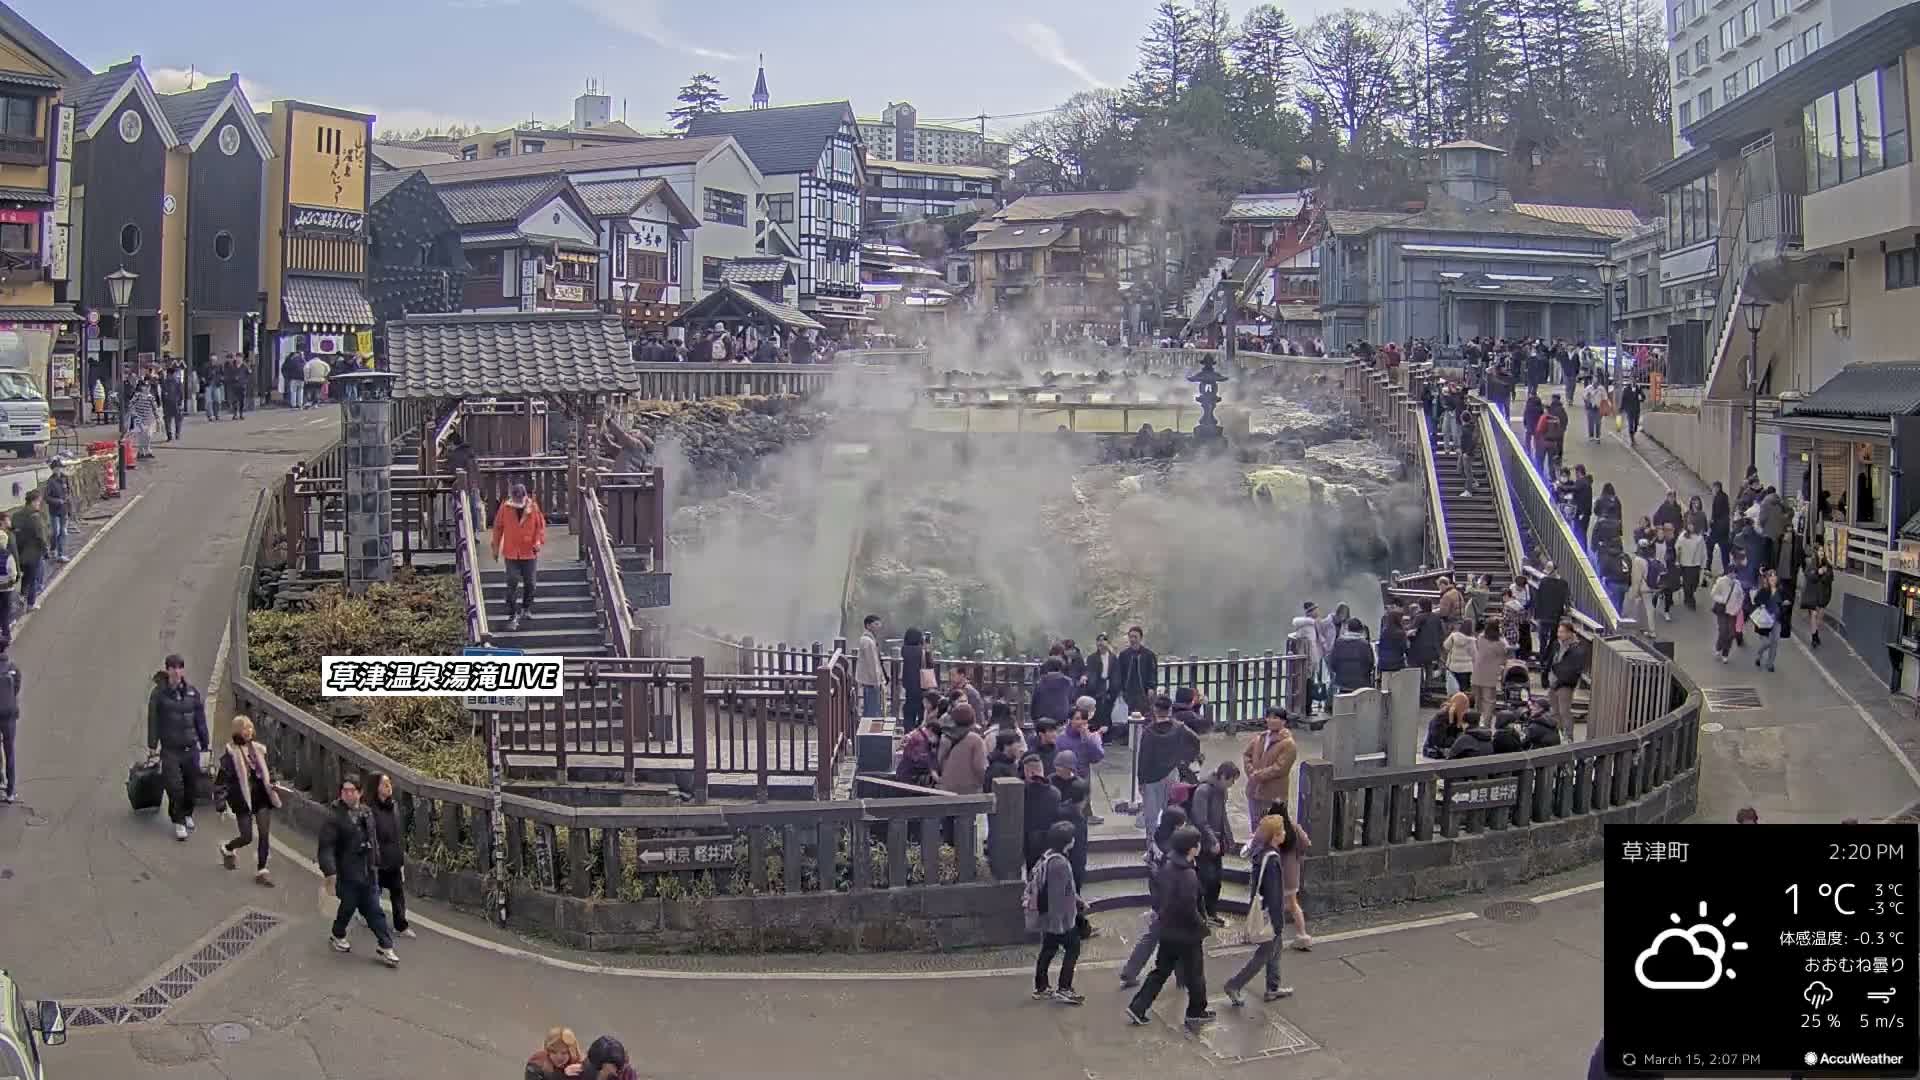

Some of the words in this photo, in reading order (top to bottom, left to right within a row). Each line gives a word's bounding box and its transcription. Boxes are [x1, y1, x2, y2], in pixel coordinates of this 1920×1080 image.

[663, 847, 691, 865] 東京
[694, 843, 734, 862] 軽井沢
